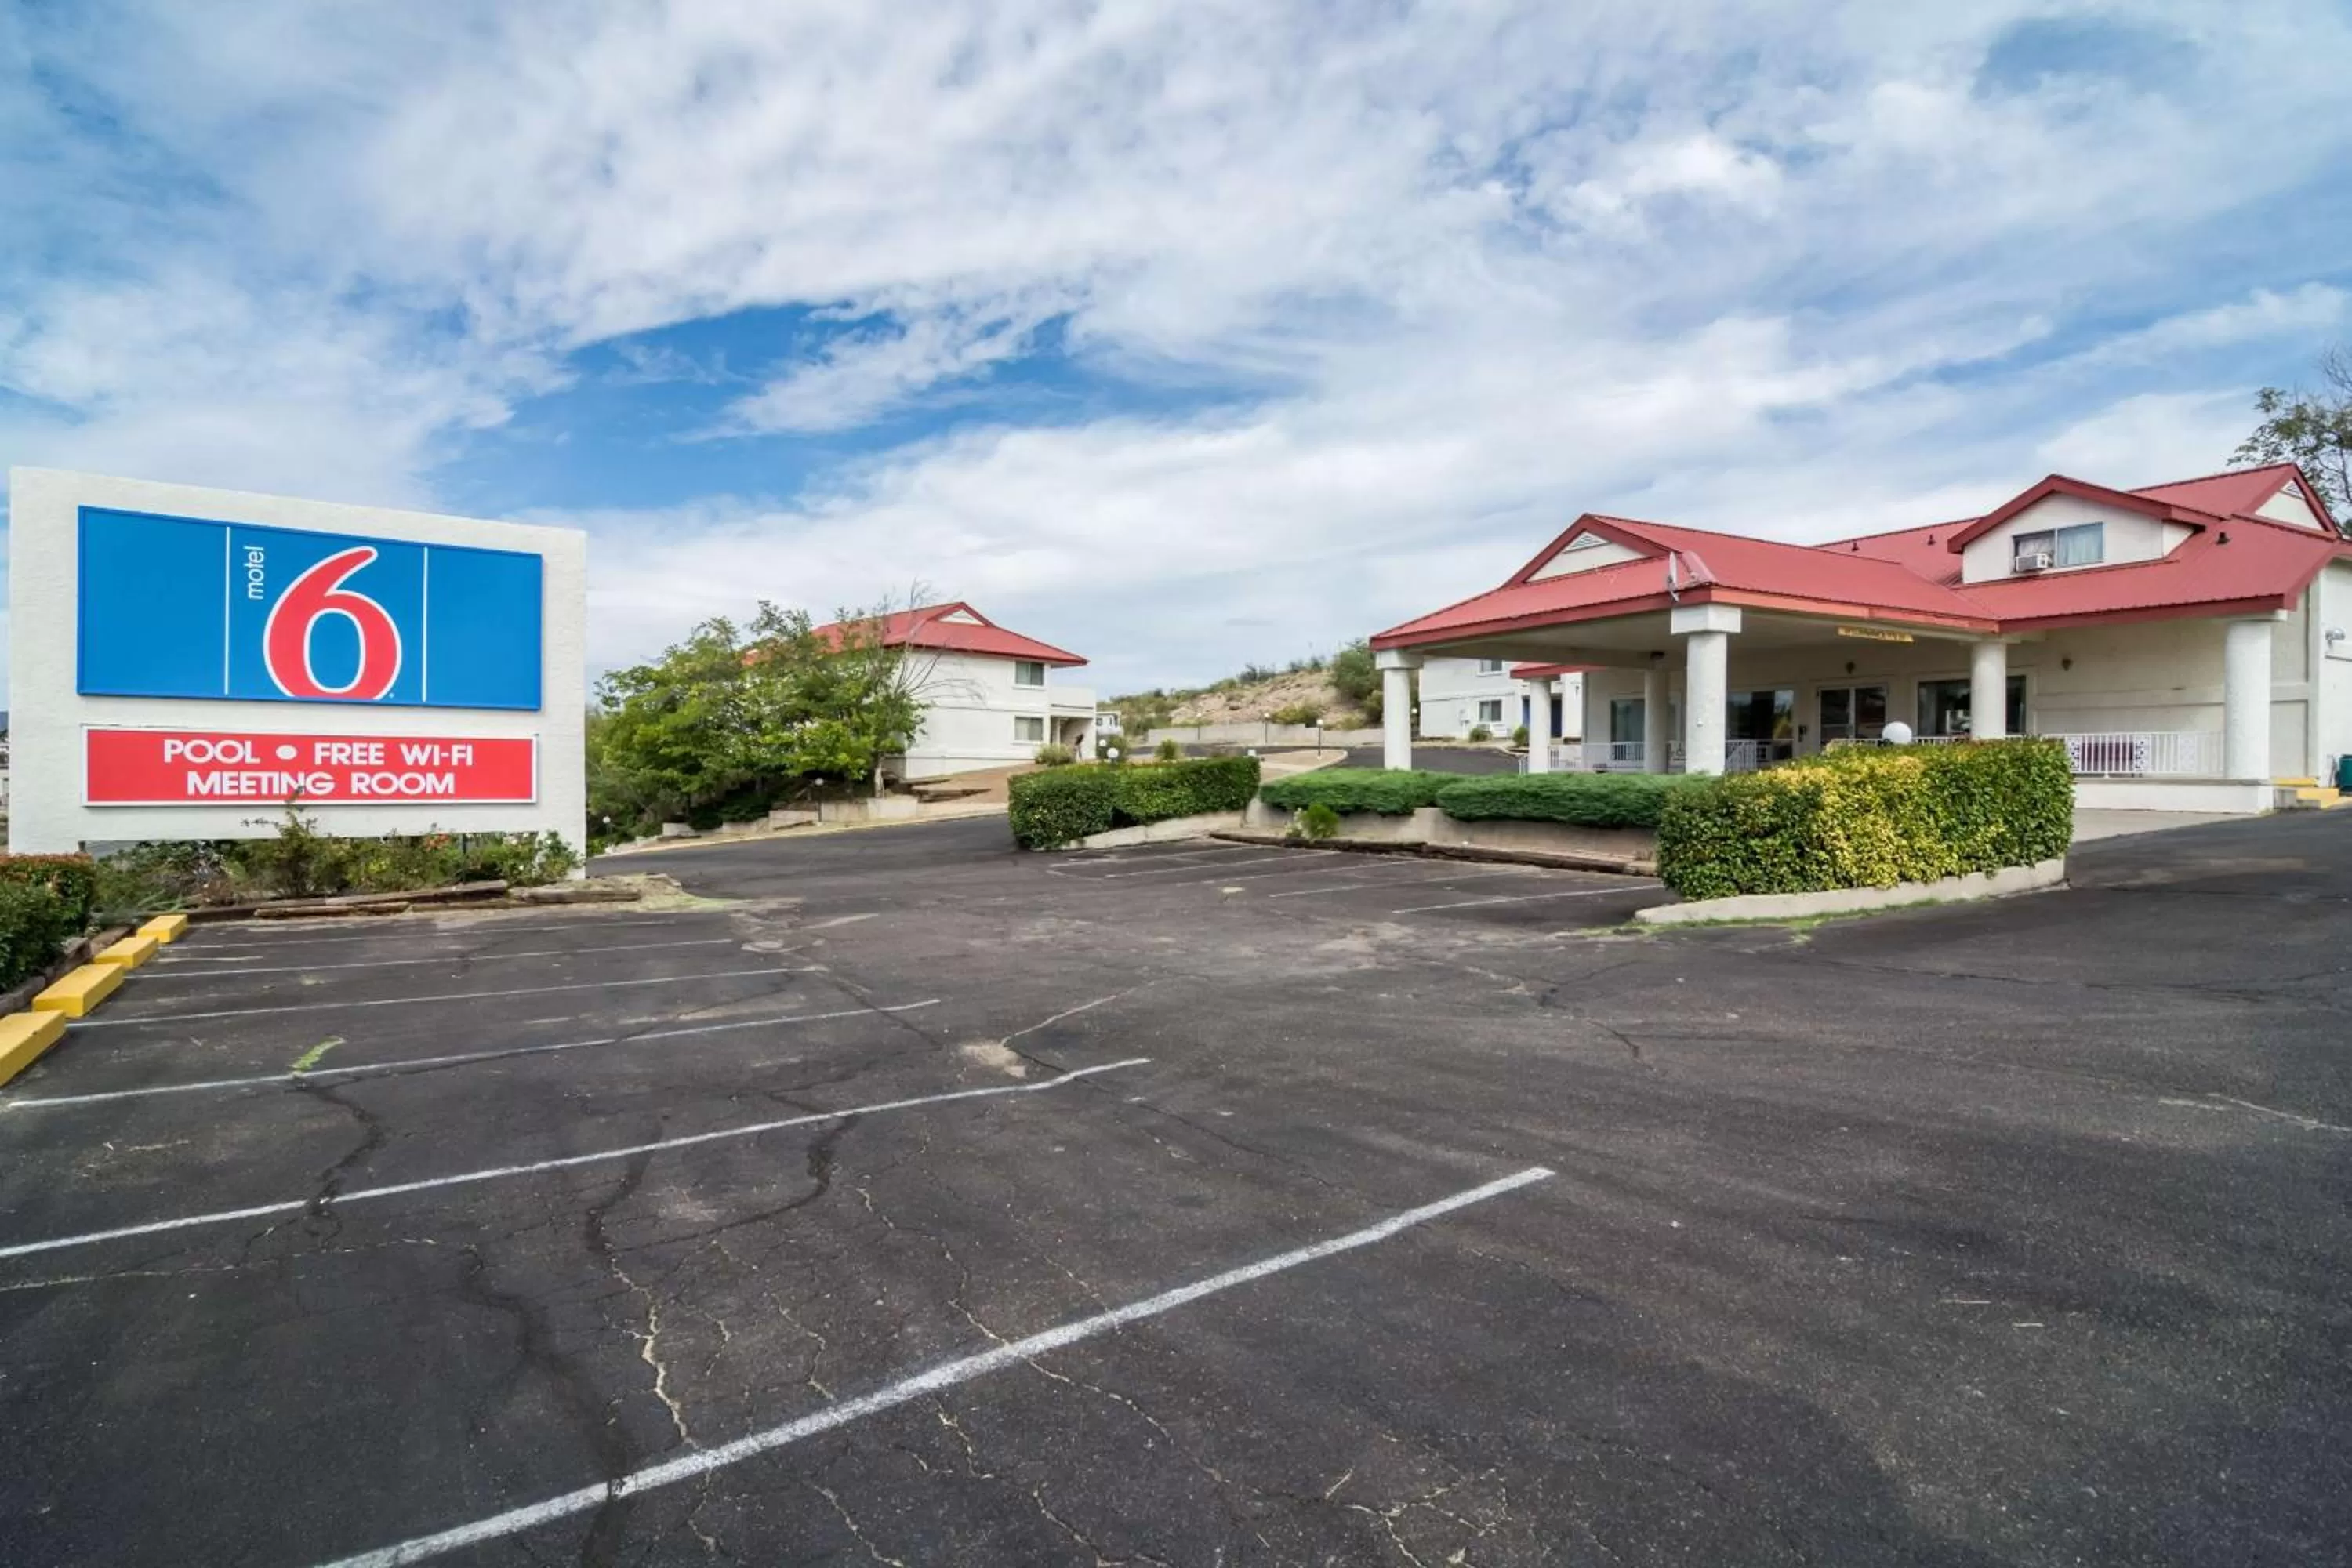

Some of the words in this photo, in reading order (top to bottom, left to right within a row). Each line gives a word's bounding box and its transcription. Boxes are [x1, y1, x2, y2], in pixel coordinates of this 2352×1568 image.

[245, 546, 263, 600] motel
[263, 546, 402, 700] 6
[163, 739, 260, 763] POOL
[314, 742, 384, 765] FREE
[401, 744, 473, 766] WI-FI
[187, 771, 335, 795] MEETING
[351, 772, 455, 794] ROOM
